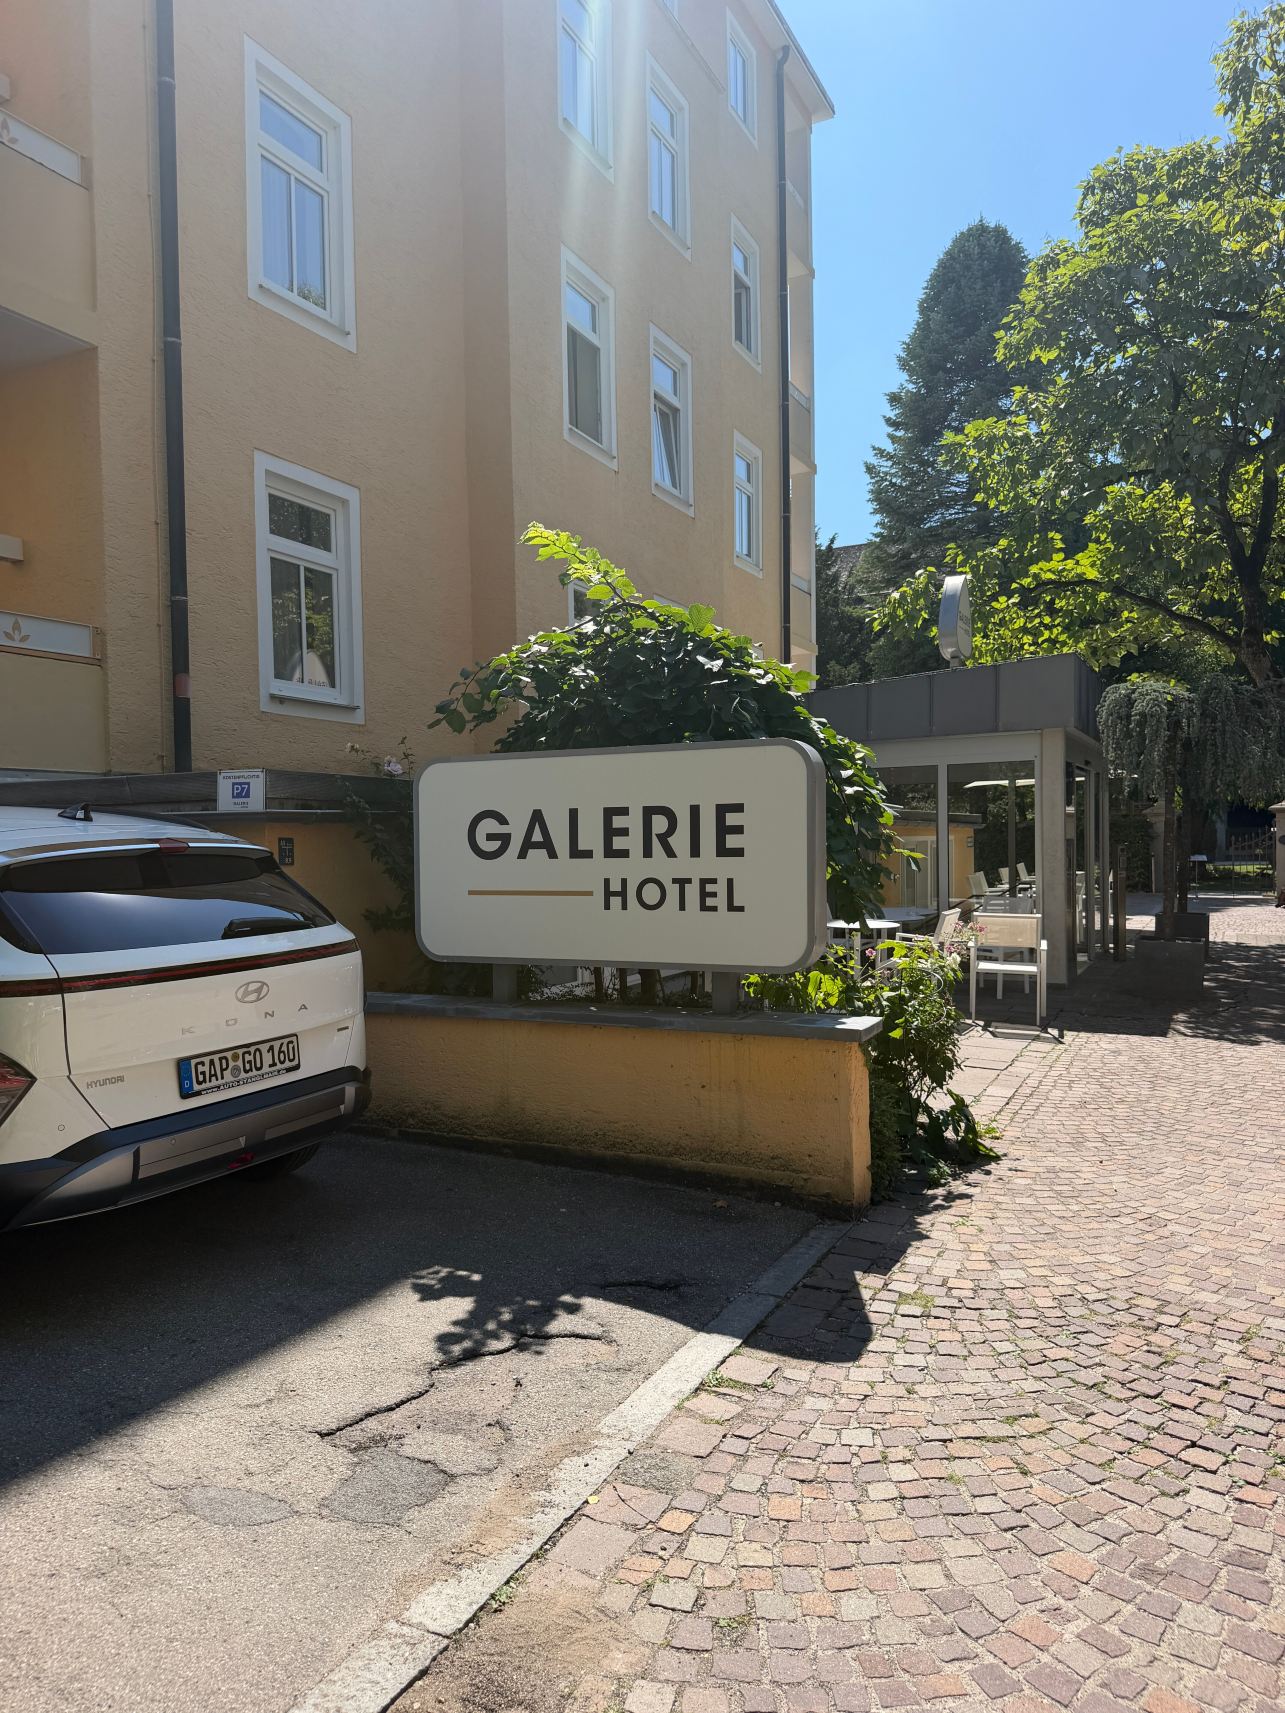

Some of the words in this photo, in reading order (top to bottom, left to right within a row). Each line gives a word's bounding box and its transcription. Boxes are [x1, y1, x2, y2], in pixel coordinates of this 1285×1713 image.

[233, 784, 249, 797] P7
[467, 803, 745, 861] GALERIE
[603, 877, 745, 912] HOTEL
[181, 1003, 309, 1035] KONA
[194, 1055, 230, 1086] GAP
[241, 1047, 264, 1075] GO
[267, 1040, 297, 1069] 160
[86, 1075, 125, 1089] HYUNDAI
[184, 1080, 190, 1088] D
